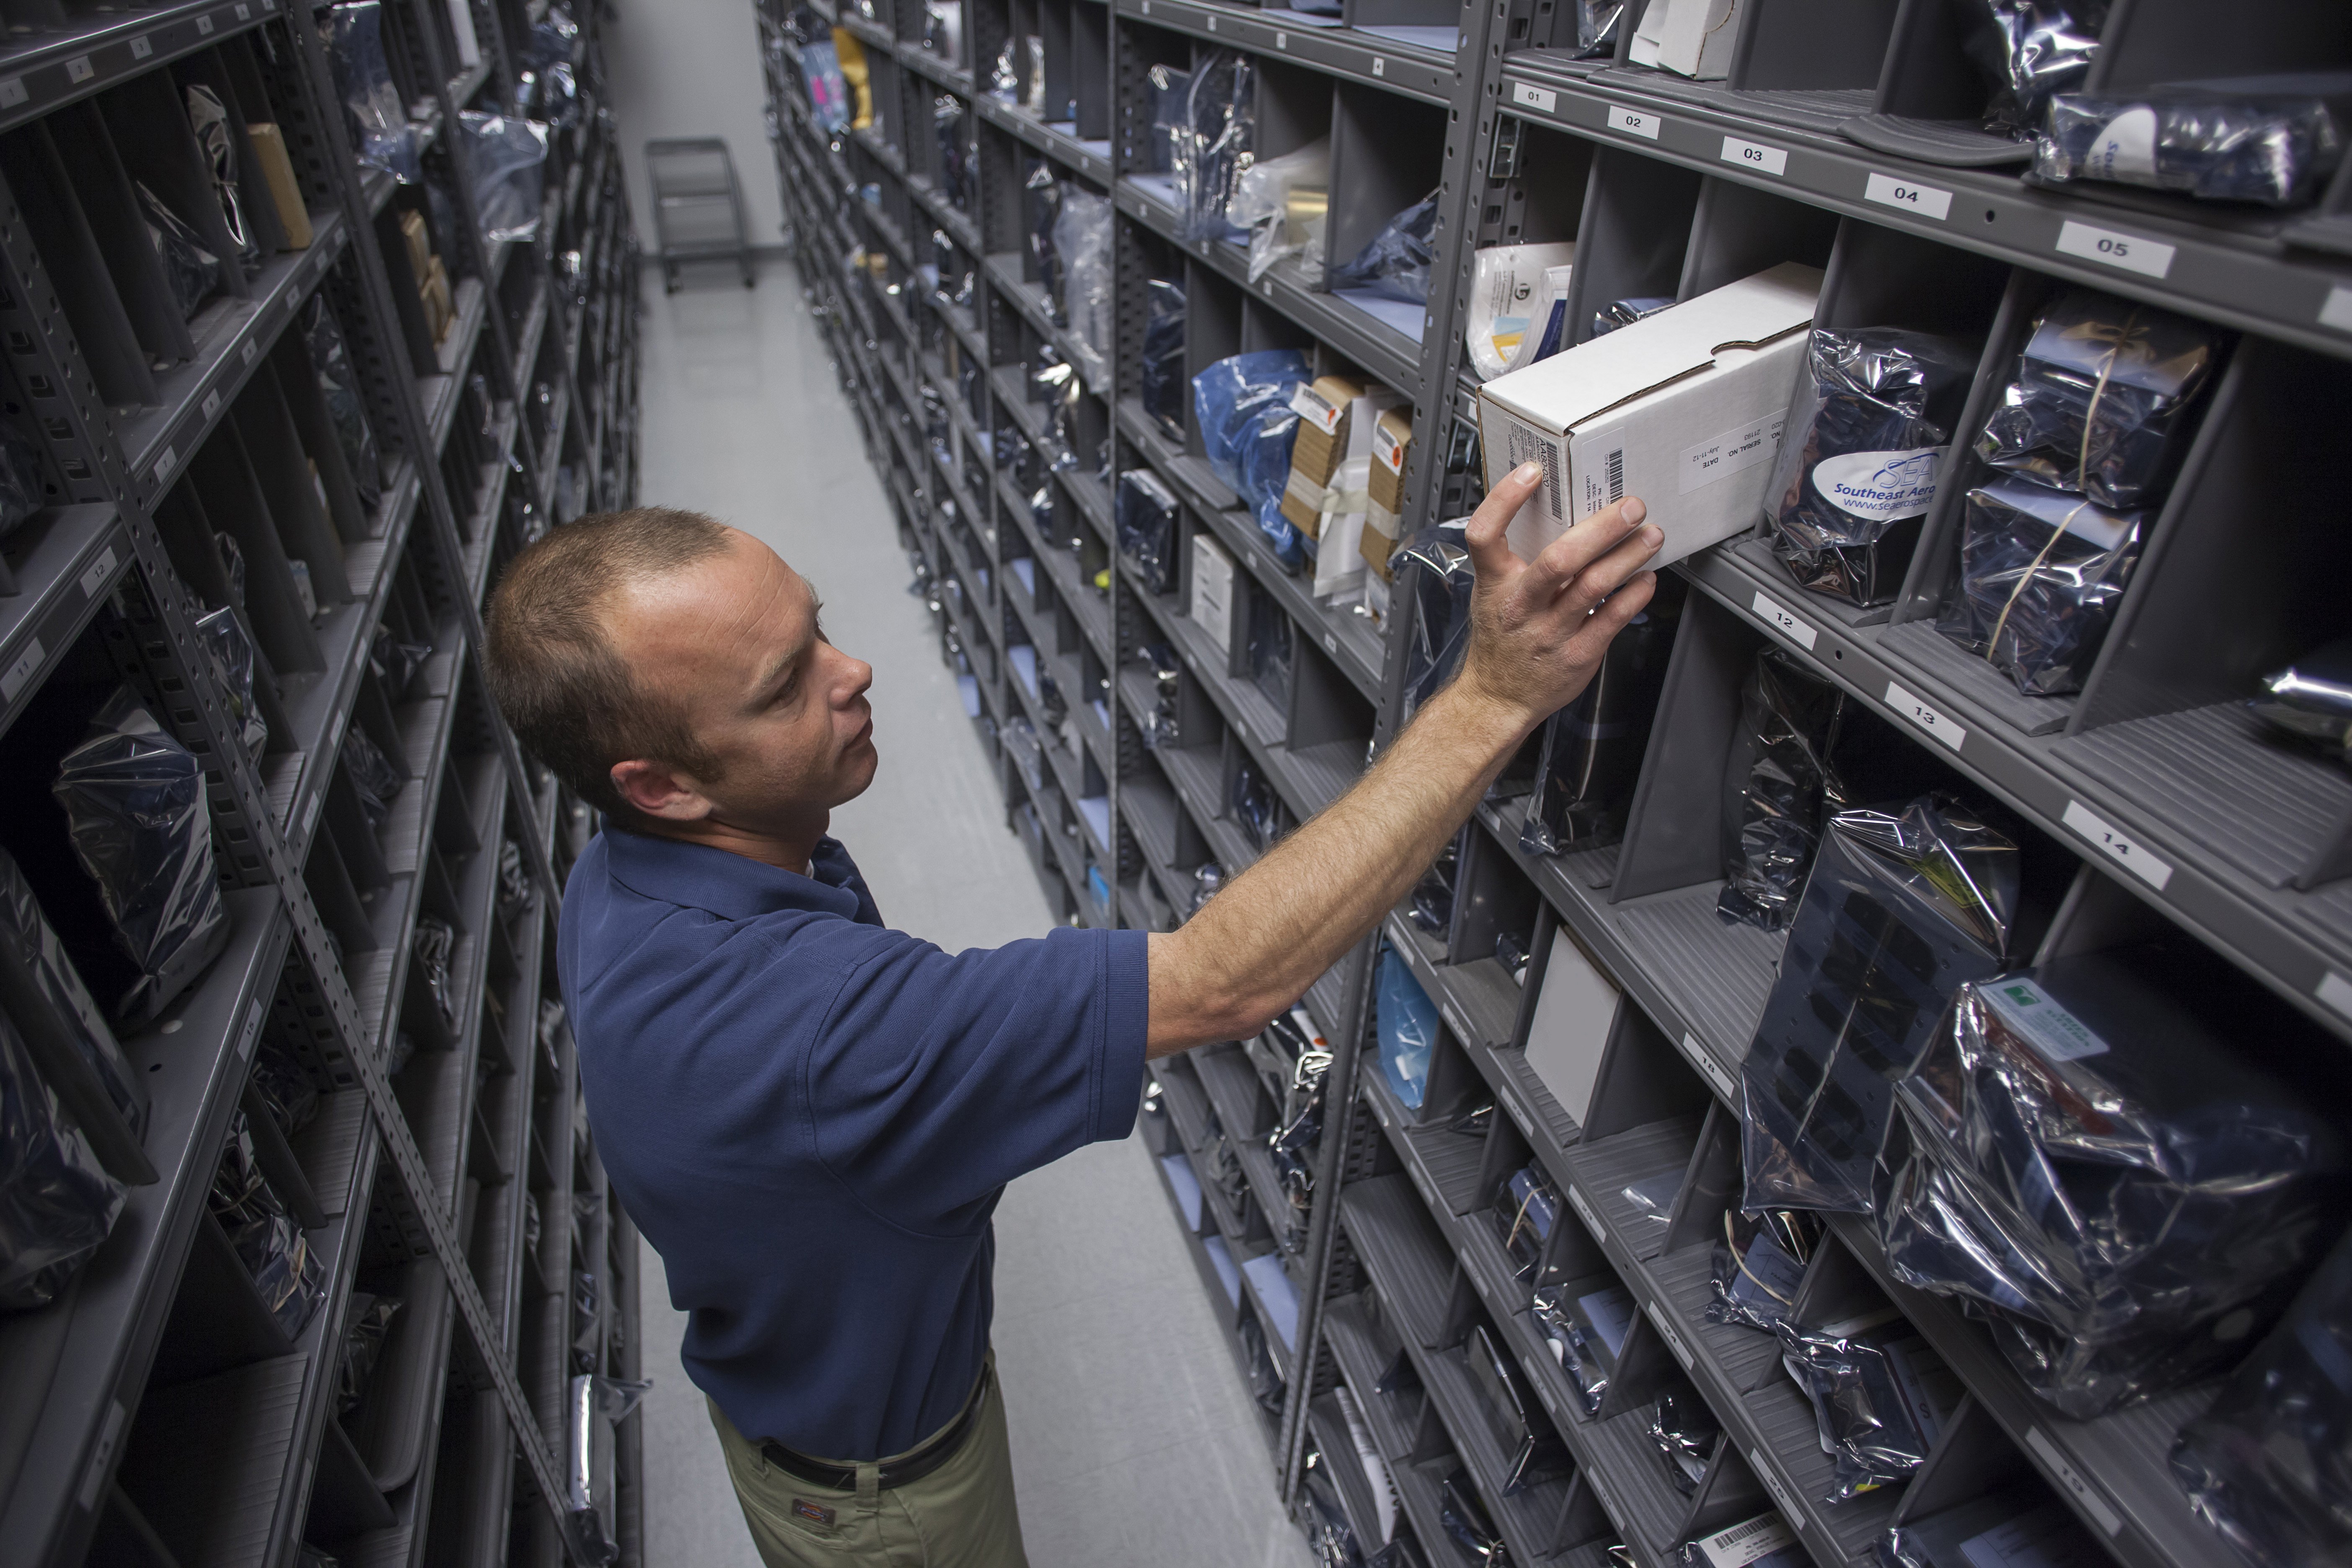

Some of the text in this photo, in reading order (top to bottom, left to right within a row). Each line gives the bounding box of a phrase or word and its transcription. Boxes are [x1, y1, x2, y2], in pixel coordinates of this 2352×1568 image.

[77, 64, 83, 75] 2
[8, 88, 15, 98] 1
[1528, 91, 1540, 101] 01
[1626, 116, 1641, 128] 02
[1743, 148, 1763, 161] 03
[1894, 187, 1919, 203] 04
[2097, 238, 2129, 257] 05
[1744, 429, 1761, 441] 21193
[1728, 448, 1738, 457] NO.
[1739, 439, 1761, 452] SERIAL
[1693, 446, 1720, 462] July-11-12
[162, 459, 168, 468] 7
[1540, 438, 1549, 487] AA80-020
[1702, 457, 1719, 469] DATE
[1879, 456, 1933, 489] SEA
[1834, 483, 1936, 500] Southeast Aero
[95, 564, 105, 578] 12
[1777, 612, 1792, 629] 12
[18, 660, 29, 677] 11
[1916, 706, 1935, 725] 13
[2104, 833, 2130, 855] 14
[1702, 1056, 1715, 1073] 18
[2062, 1466, 2084, 1493] 19
[1769, 1477, 1784, 1499] 25
